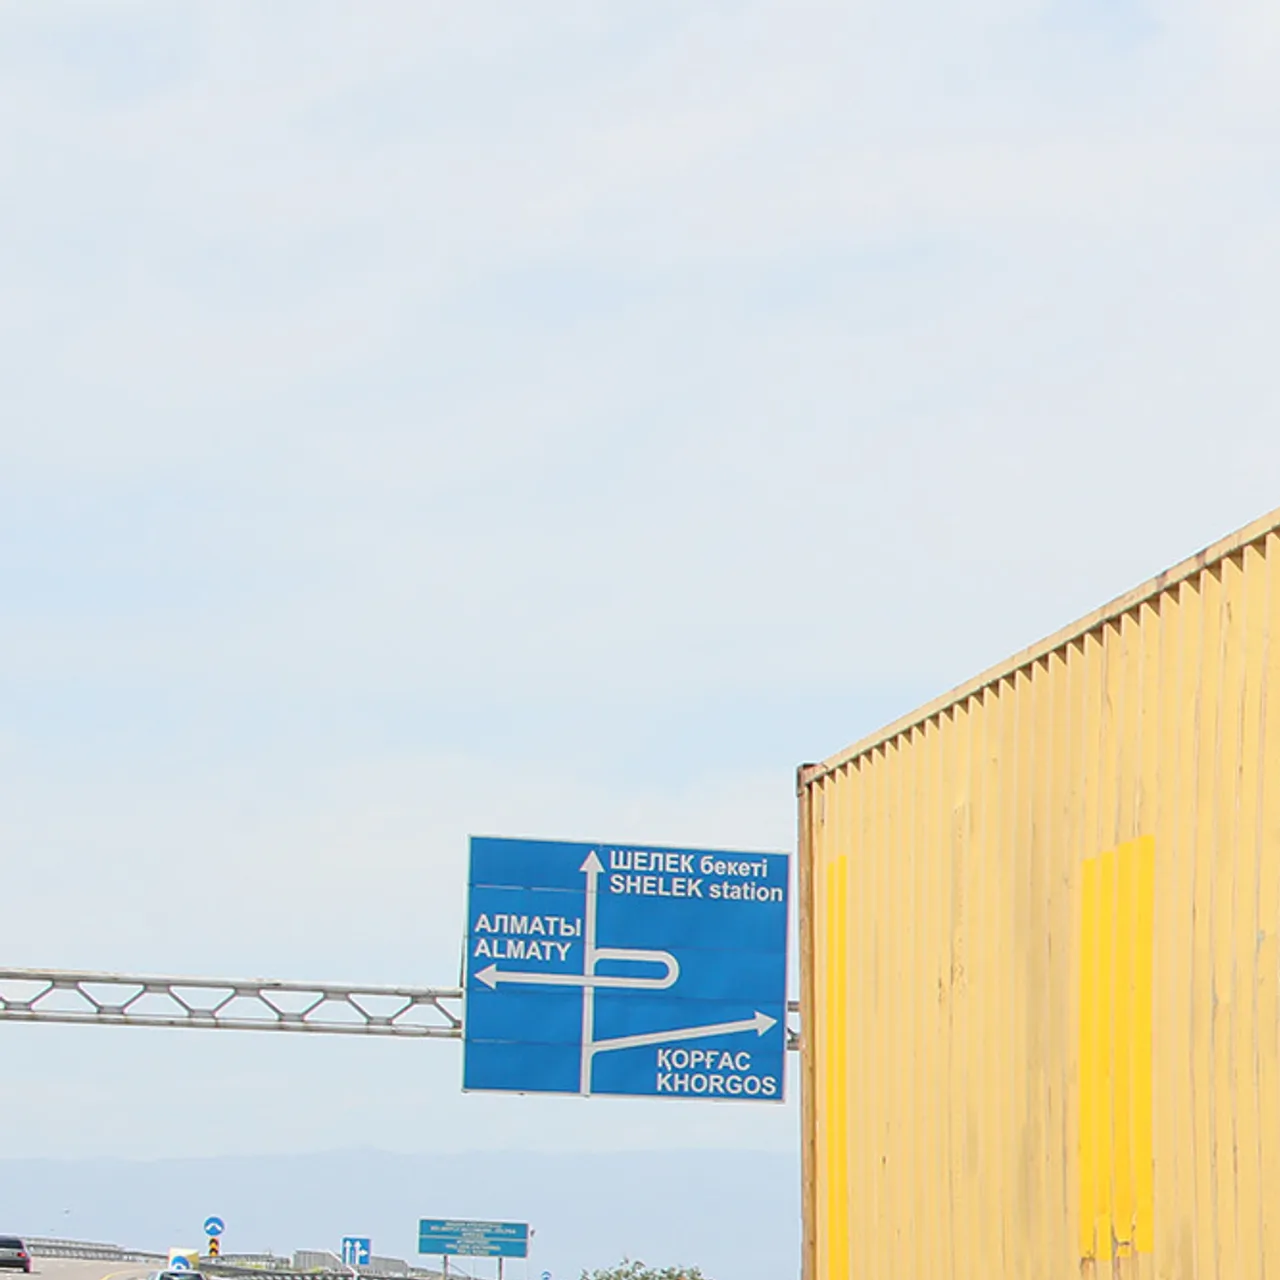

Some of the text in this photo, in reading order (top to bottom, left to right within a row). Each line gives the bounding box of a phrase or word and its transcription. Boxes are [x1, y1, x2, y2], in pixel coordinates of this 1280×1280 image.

[609, 850, 768, 878] ШЕЛЕК бекеті
[609, 875, 784, 902] SHELEK station
[474, 913, 582, 937] АЛМАТЫ
[473, 938, 572, 961] ALMATY
[656, 1073, 777, 1096] KHORGOS
